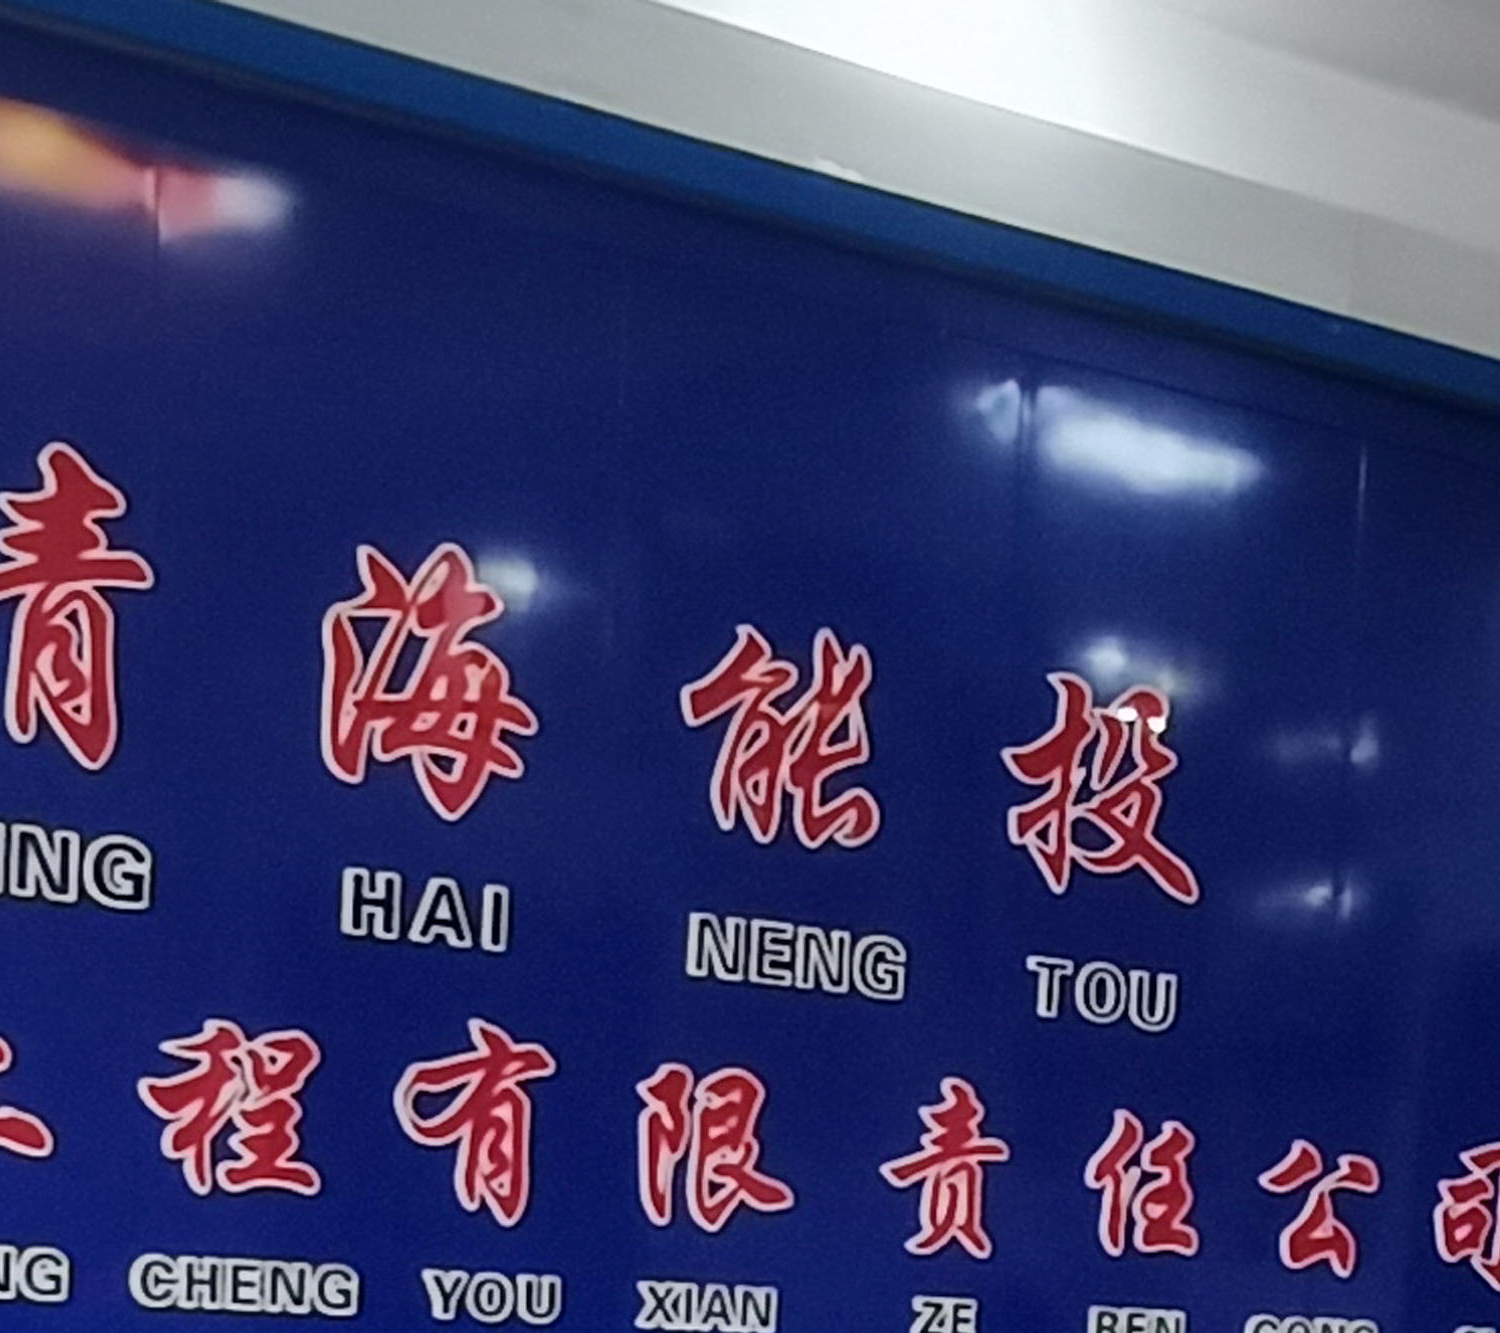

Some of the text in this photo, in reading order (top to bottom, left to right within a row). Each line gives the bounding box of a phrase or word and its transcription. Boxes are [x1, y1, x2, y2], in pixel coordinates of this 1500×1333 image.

[339, 868, 511, 953] HAI
[685, 913, 908, 1001] NENG
[1026, 956, 1177, 1031] TOU
[129, 1254, 360, 1317] CHENG
[423, 1269, 563, 1325] YOU
